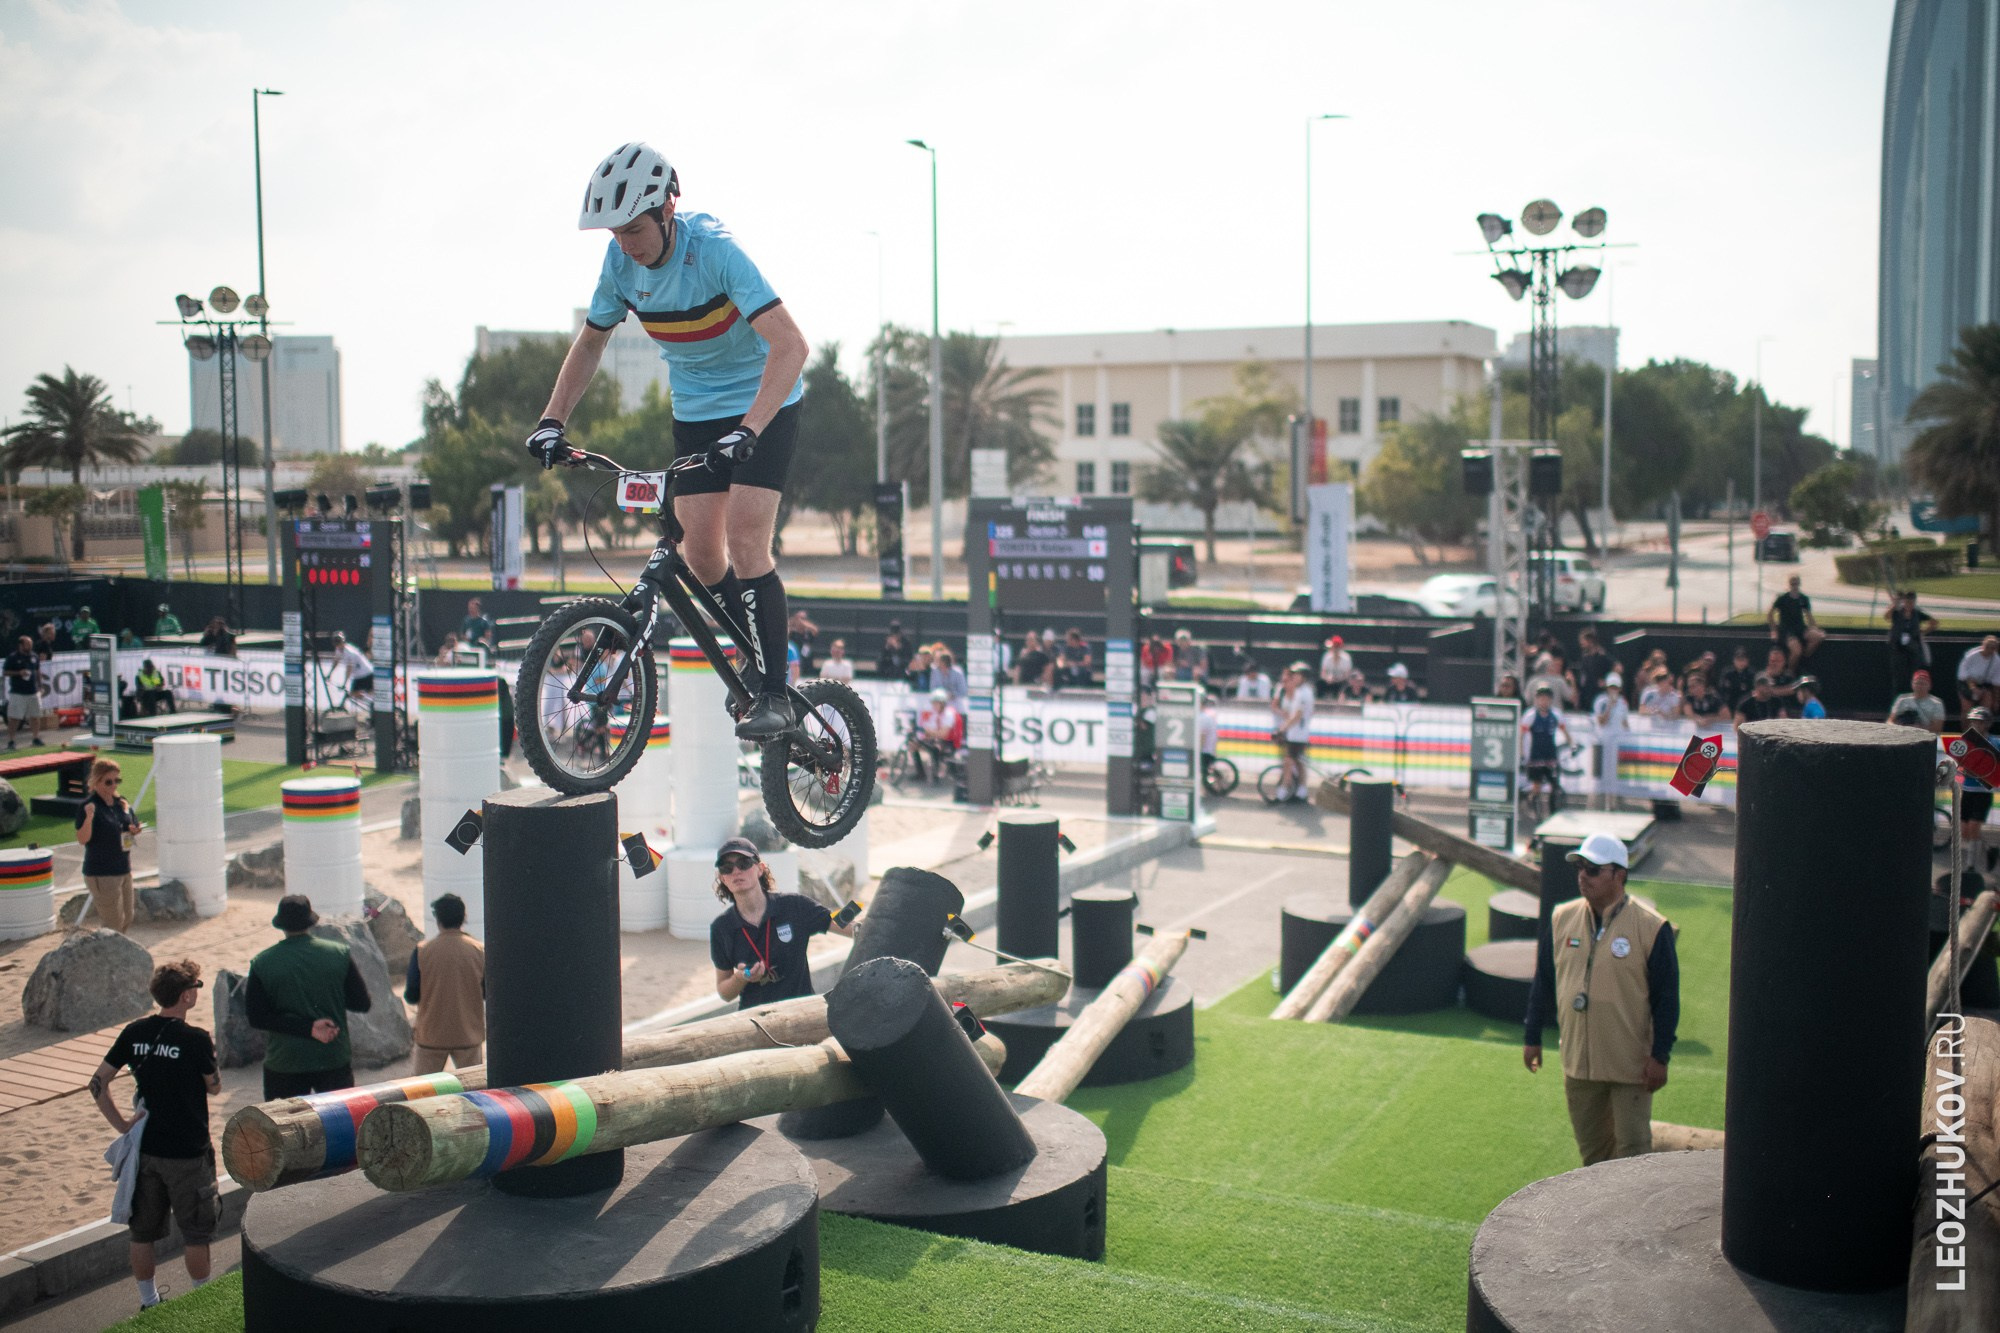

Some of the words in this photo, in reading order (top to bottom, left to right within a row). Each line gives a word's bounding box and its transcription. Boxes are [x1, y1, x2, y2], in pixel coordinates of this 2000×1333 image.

[627, 192, 642, 217] hebo
[627, 484, 657, 501] 308
[745, 609, 767, 675] CLEAN
[203, 667, 286, 696] TISSO
[996, 716, 1103, 747] SSOT
[1166, 718, 1185, 747] 2
[1474, 725, 1514, 738] START
[1483, 739, 1504, 768] 3
[1702, 744, 1716, 757] 5B
[1950, 741, 1966, 755] 5B
